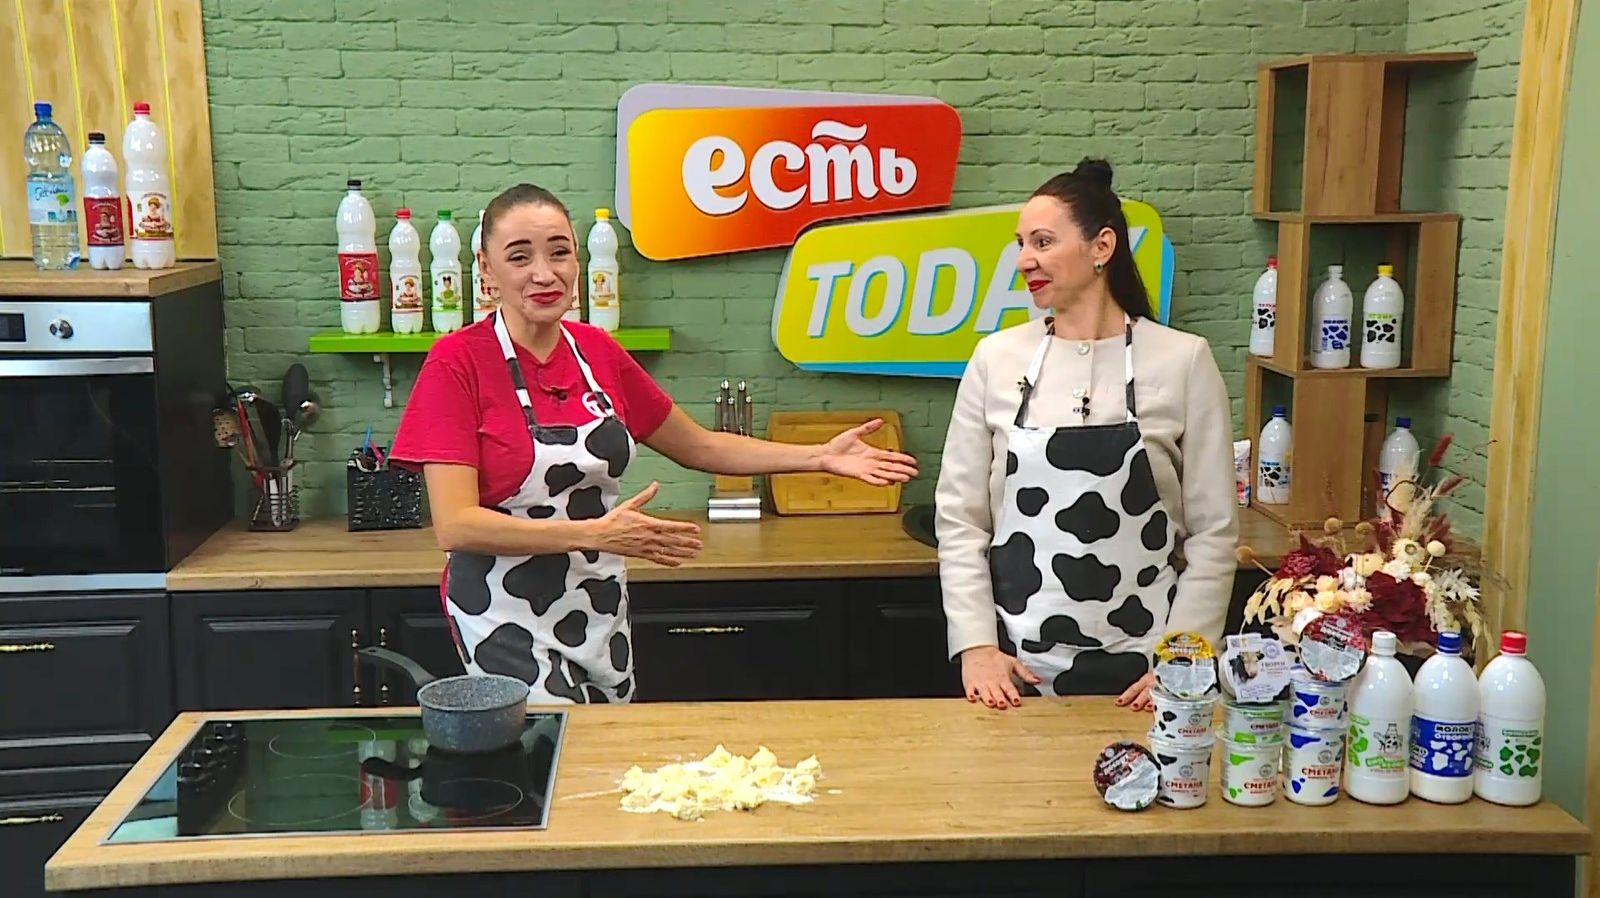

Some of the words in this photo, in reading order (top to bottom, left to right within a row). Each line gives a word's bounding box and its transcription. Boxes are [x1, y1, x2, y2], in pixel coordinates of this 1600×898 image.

[681, 120, 917, 217] есть
[806, 228, 1148, 338] TODA
[1165, 780, 1203, 789] СМЕТАНА
